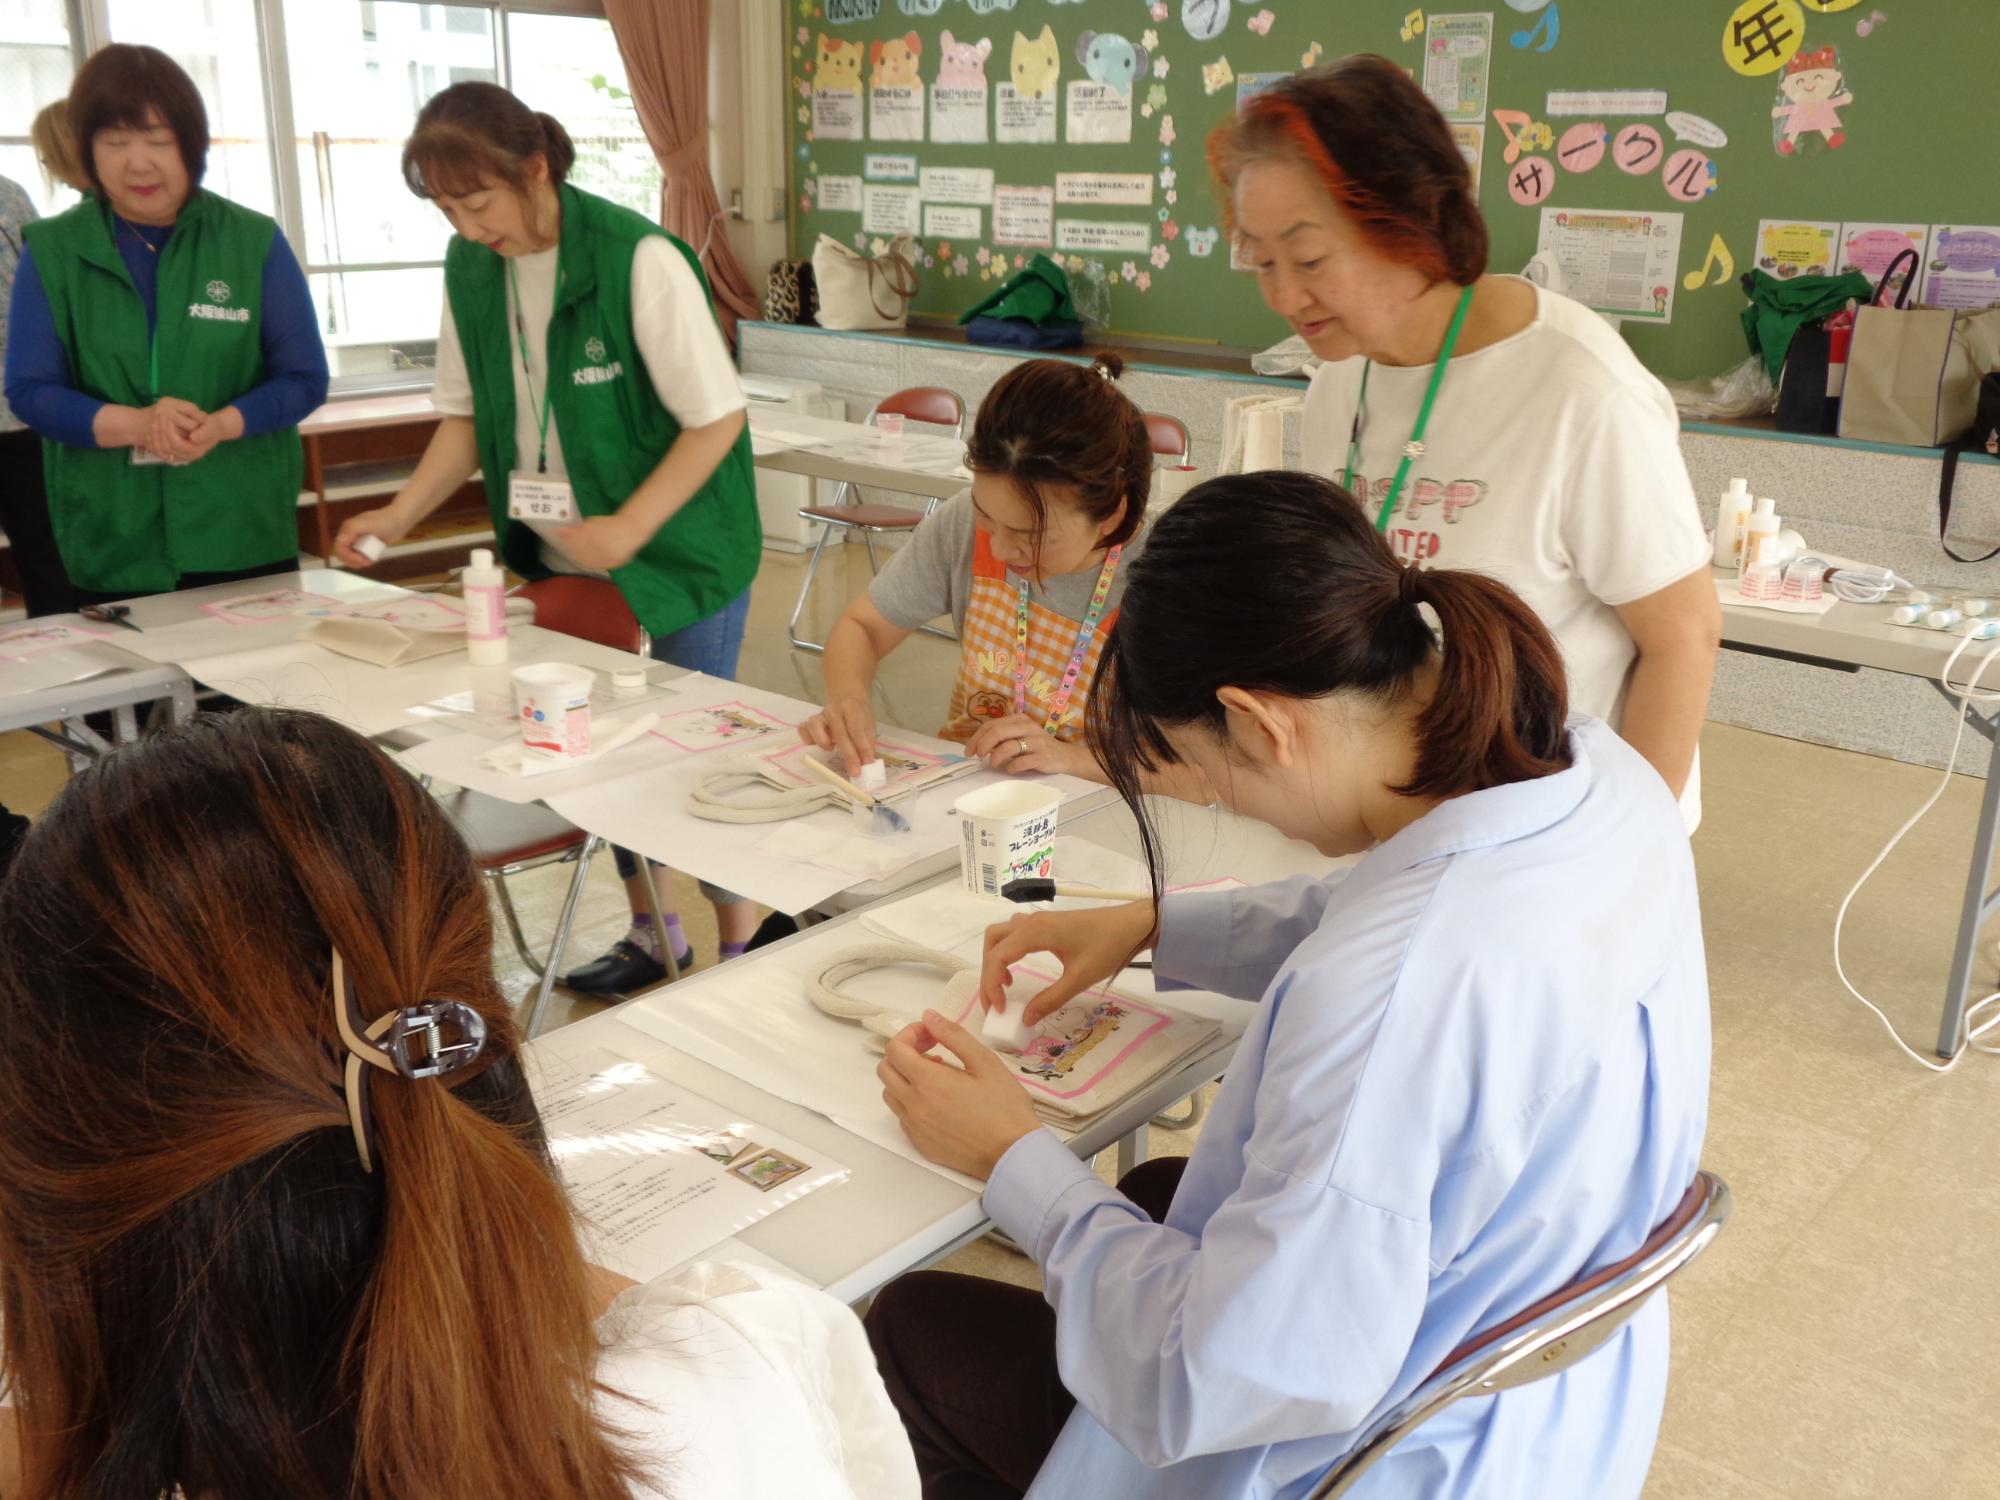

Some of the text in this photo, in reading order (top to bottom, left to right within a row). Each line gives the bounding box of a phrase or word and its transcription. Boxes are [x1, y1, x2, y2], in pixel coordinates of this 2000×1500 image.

[1734, 0, 1793, 65] 年
[1514, 130, 1702, 199] サークル
